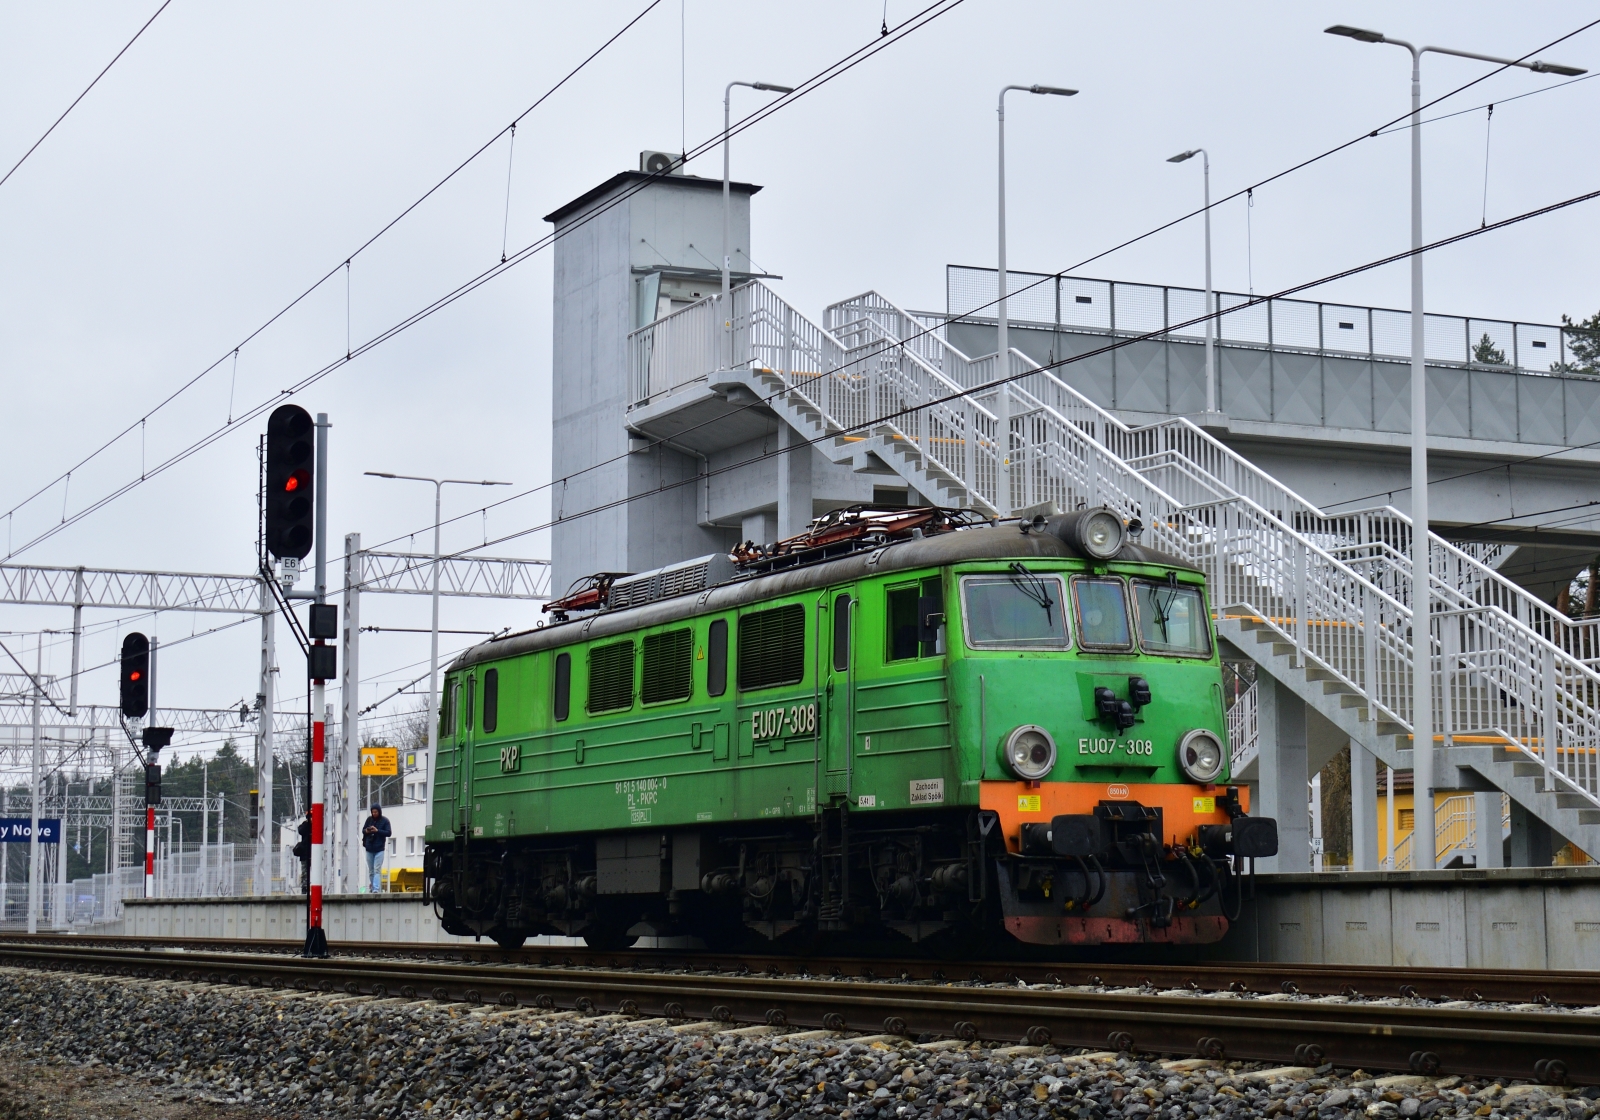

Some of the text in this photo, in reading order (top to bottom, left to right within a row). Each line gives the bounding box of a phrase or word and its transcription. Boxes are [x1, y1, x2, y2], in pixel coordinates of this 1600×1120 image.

[284, 558, 296, 568] E6
[752, 703, 815, 739] EU07-308
[1078, 738, 1153, 755] EU07-308
[500, 745, 518, 770] PKP
[915, 781, 939, 791] Zachodni
